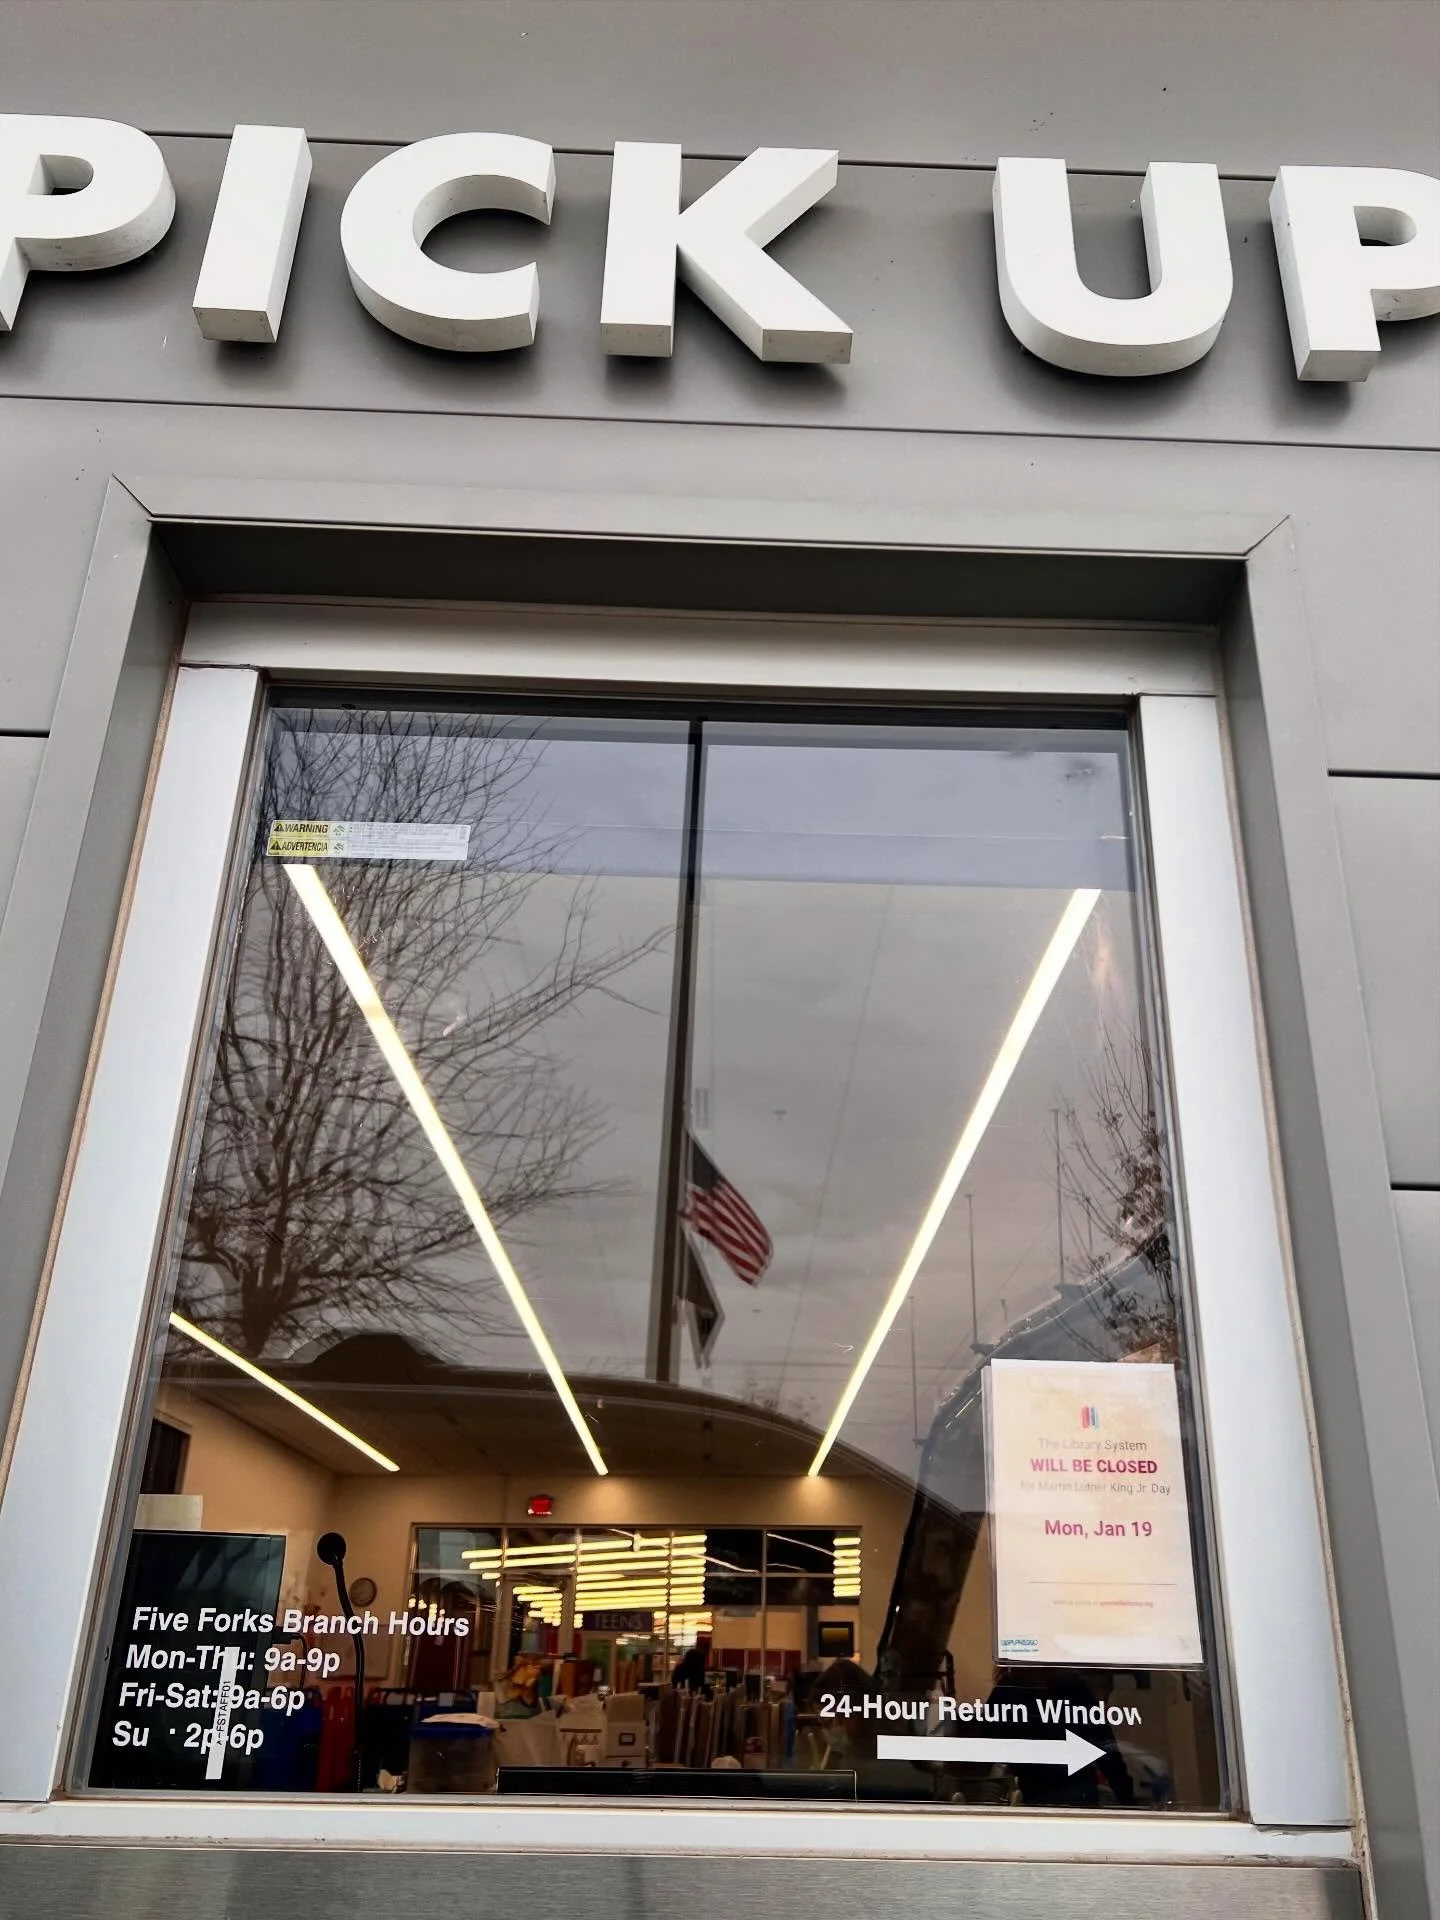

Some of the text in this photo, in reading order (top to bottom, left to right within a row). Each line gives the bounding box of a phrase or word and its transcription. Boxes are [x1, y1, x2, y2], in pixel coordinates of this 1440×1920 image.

[0, 113, 1440, 382] PICK UP
[285, 823, 329, 833] WARNING
[282, 842, 328, 852] ADVERTENCIA
[1039, 1438, 1147, 1452] The Library System
[1030, 1458, 1158, 1474] WILL BE CLOSED
[1038, 1481, 1072, 1492] Martin
[1074, 1482, 1108, 1493] Luther
[1110, 1483, 1133, 1495] King
[1136, 1484, 1147, 1494] Jr
[1151, 1484, 1171, 1495] Day
[1045, 1519, 1153, 1539] Mon, Jan 19
[132, 1607, 470, 1637] Five Forks Branch Hours
[264, 1648, 341, 1678] 9a-9p
[119, 1682, 305, 1716] Fri-Sat: 9a-6p
[819, 1693, 930, 1720] 24-Hour
[938, 1696, 1029, 1723] Return
[183, 1722, 265, 1756] 2p6p
